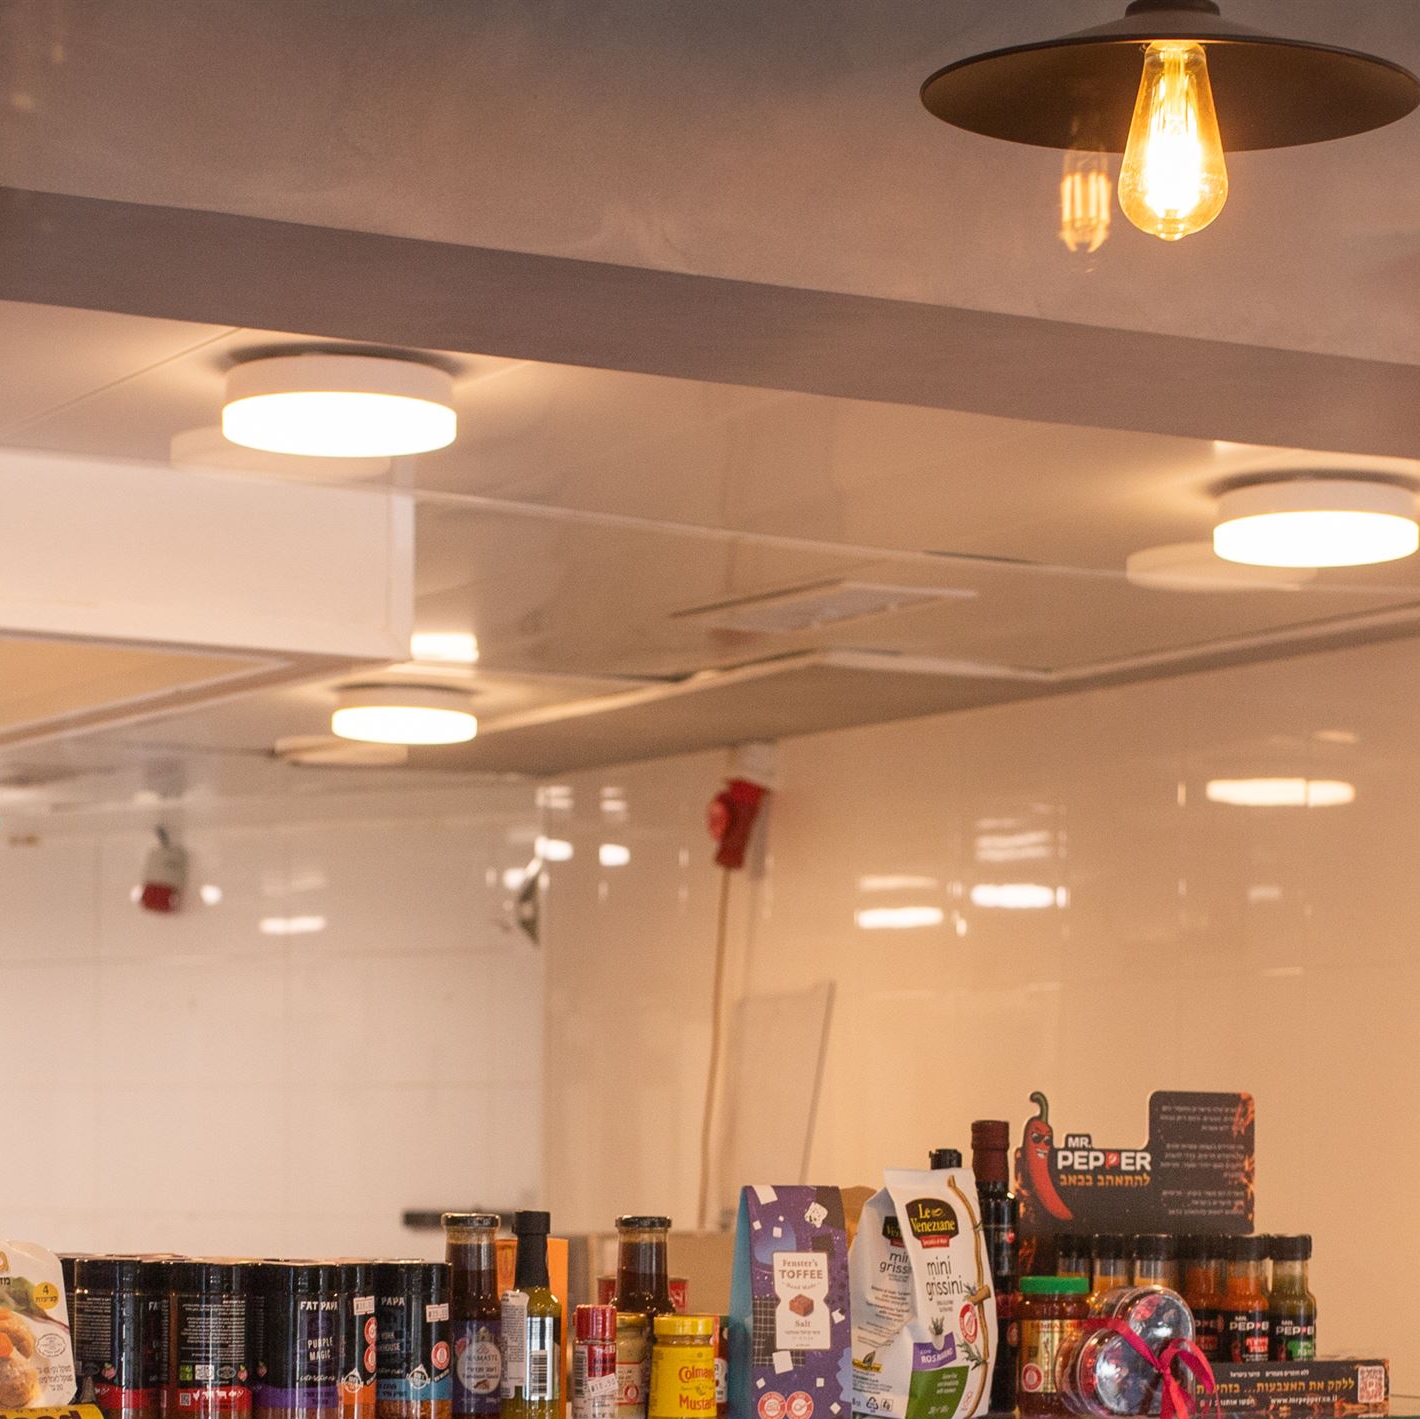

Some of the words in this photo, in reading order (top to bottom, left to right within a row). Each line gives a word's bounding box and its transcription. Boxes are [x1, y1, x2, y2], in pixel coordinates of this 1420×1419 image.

[1067, 1136, 1093, 1149] MR.
[1057, 1150, 1152, 1171] PEPPER
[1060, 1174, 1094, 1187] בכאב
[1097, 1173, 1152, 1187] להתאהב
[918, 1203, 931, 1219] Le
[910, 1216, 957, 1234] Veneziane
[782, 1258, 819, 1268] Fenster's
[926, 1256, 953, 1277] mini
[778, 1269, 824, 1280] TOFFEE
[42, 1284, 49, 1295] 4
[925, 1275, 963, 1302] grissini
[300, 1300, 320, 1311] FAT
[380, 1296, 406, 1307] PAPA
[795, 1319, 811, 1328] Salt
[307, 1335, 334, 1350] PURPLE
[309, 1349, 332, 1362] MAGIC
[1309, 1379, 1325, 1391] את
[1327, 1377, 1355, 1391] ללקק
